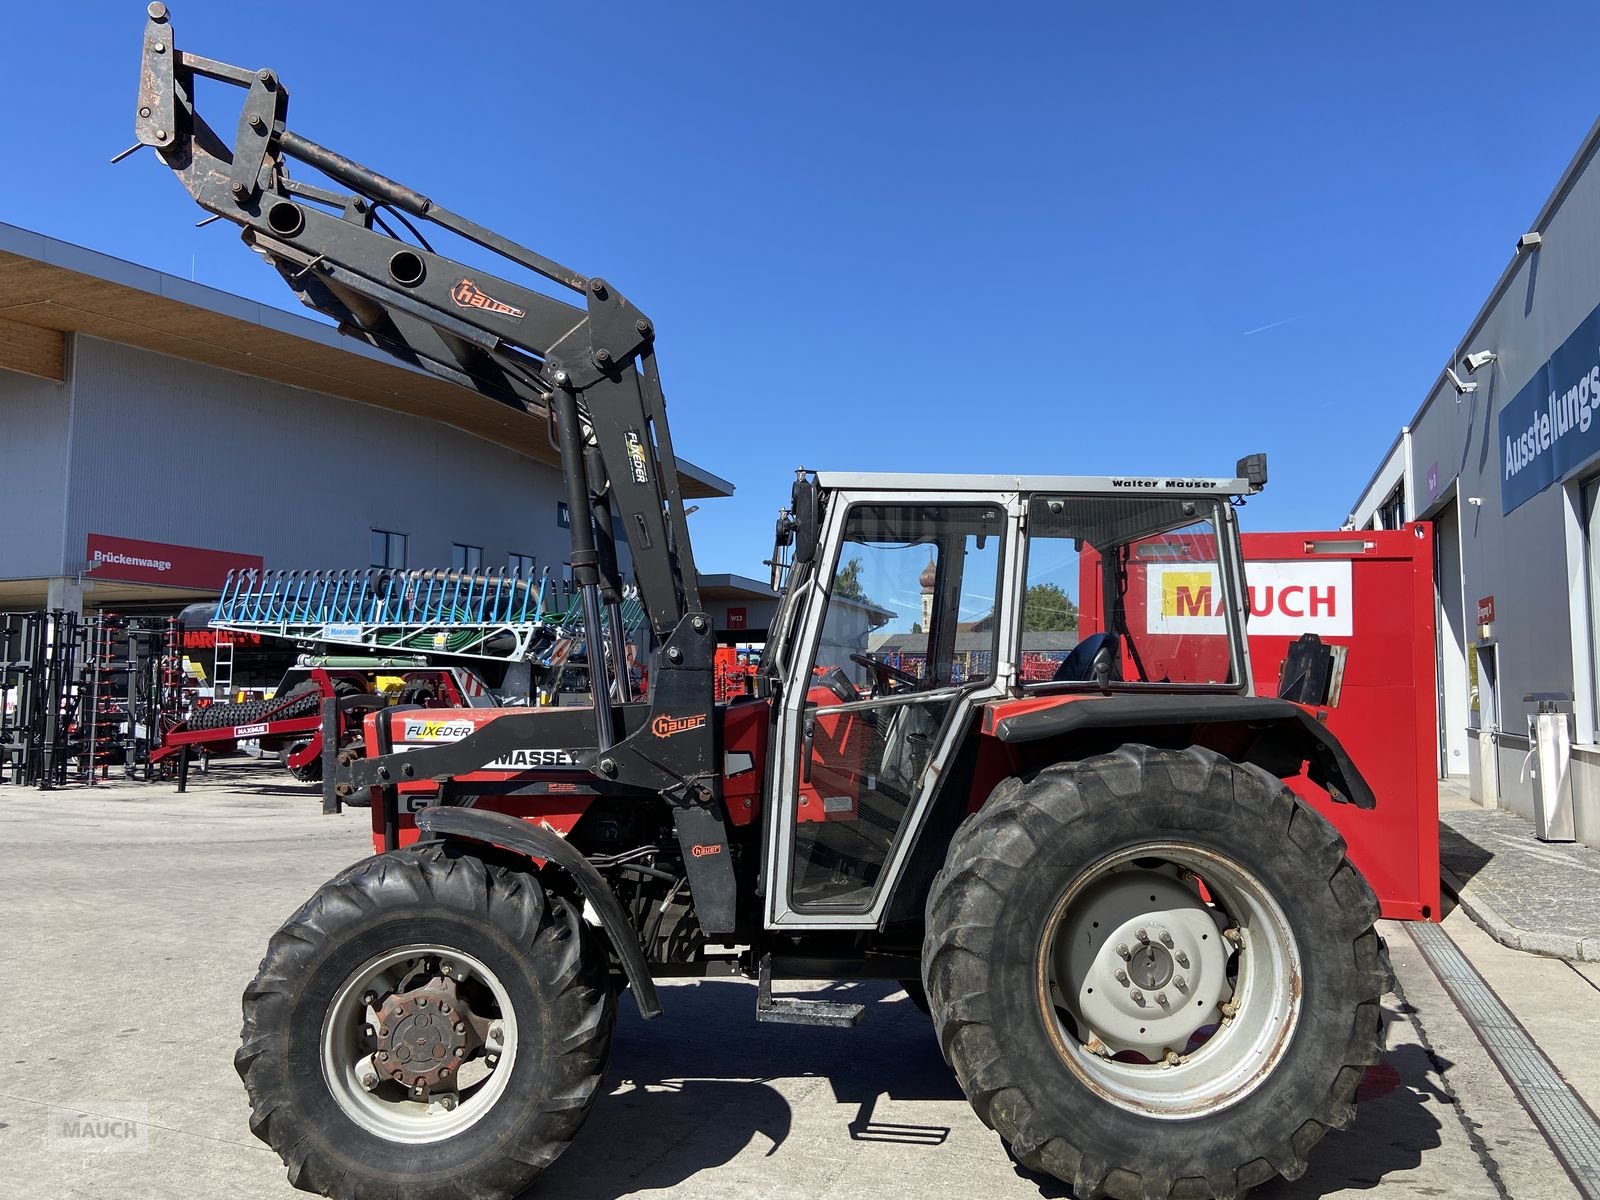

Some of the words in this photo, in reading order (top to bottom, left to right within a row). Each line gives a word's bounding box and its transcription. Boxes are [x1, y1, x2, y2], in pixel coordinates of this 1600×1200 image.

[1505, 347, 1600, 481] Ausstellungs
[1112, 480, 1158, 488] Walter
[1165, 480, 1217, 489] Mauser
[93, 550, 172, 572] Brückenwaage
[1176, 585, 1336, 617] MUCH
[406, 725, 471, 738] FLIXEDER
[657, 715, 706, 734] hauer
[494, 750, 579, 767] MASSEY
